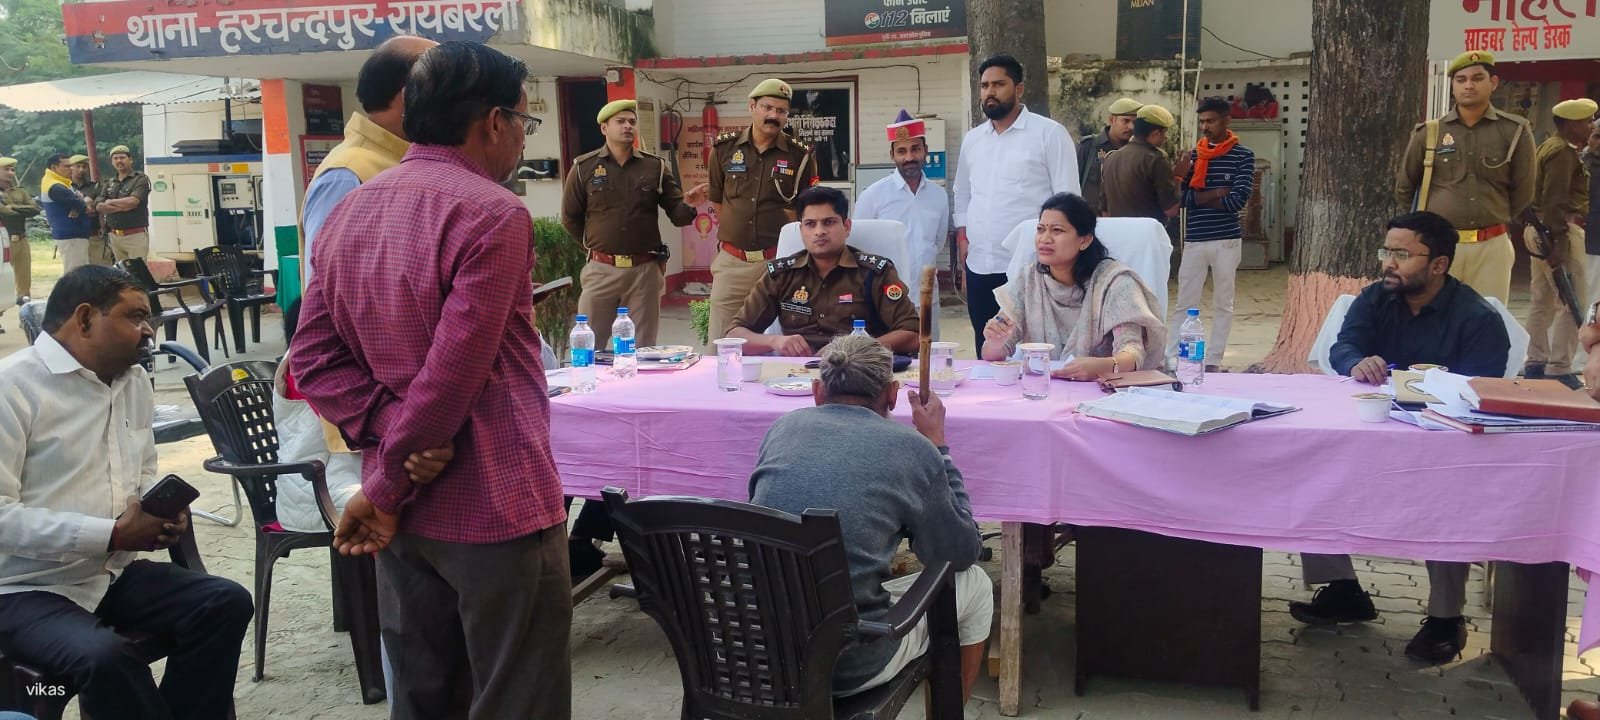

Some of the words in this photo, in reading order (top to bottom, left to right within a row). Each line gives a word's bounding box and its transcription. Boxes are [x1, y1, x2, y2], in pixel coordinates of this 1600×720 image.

[880, 10, 908, 27] 112
[910, 6, 951, 25] मिलाएं
[1512, 20, 1539, 51] हेल्प
[1543, 18, 1573, 49] डेस्क
